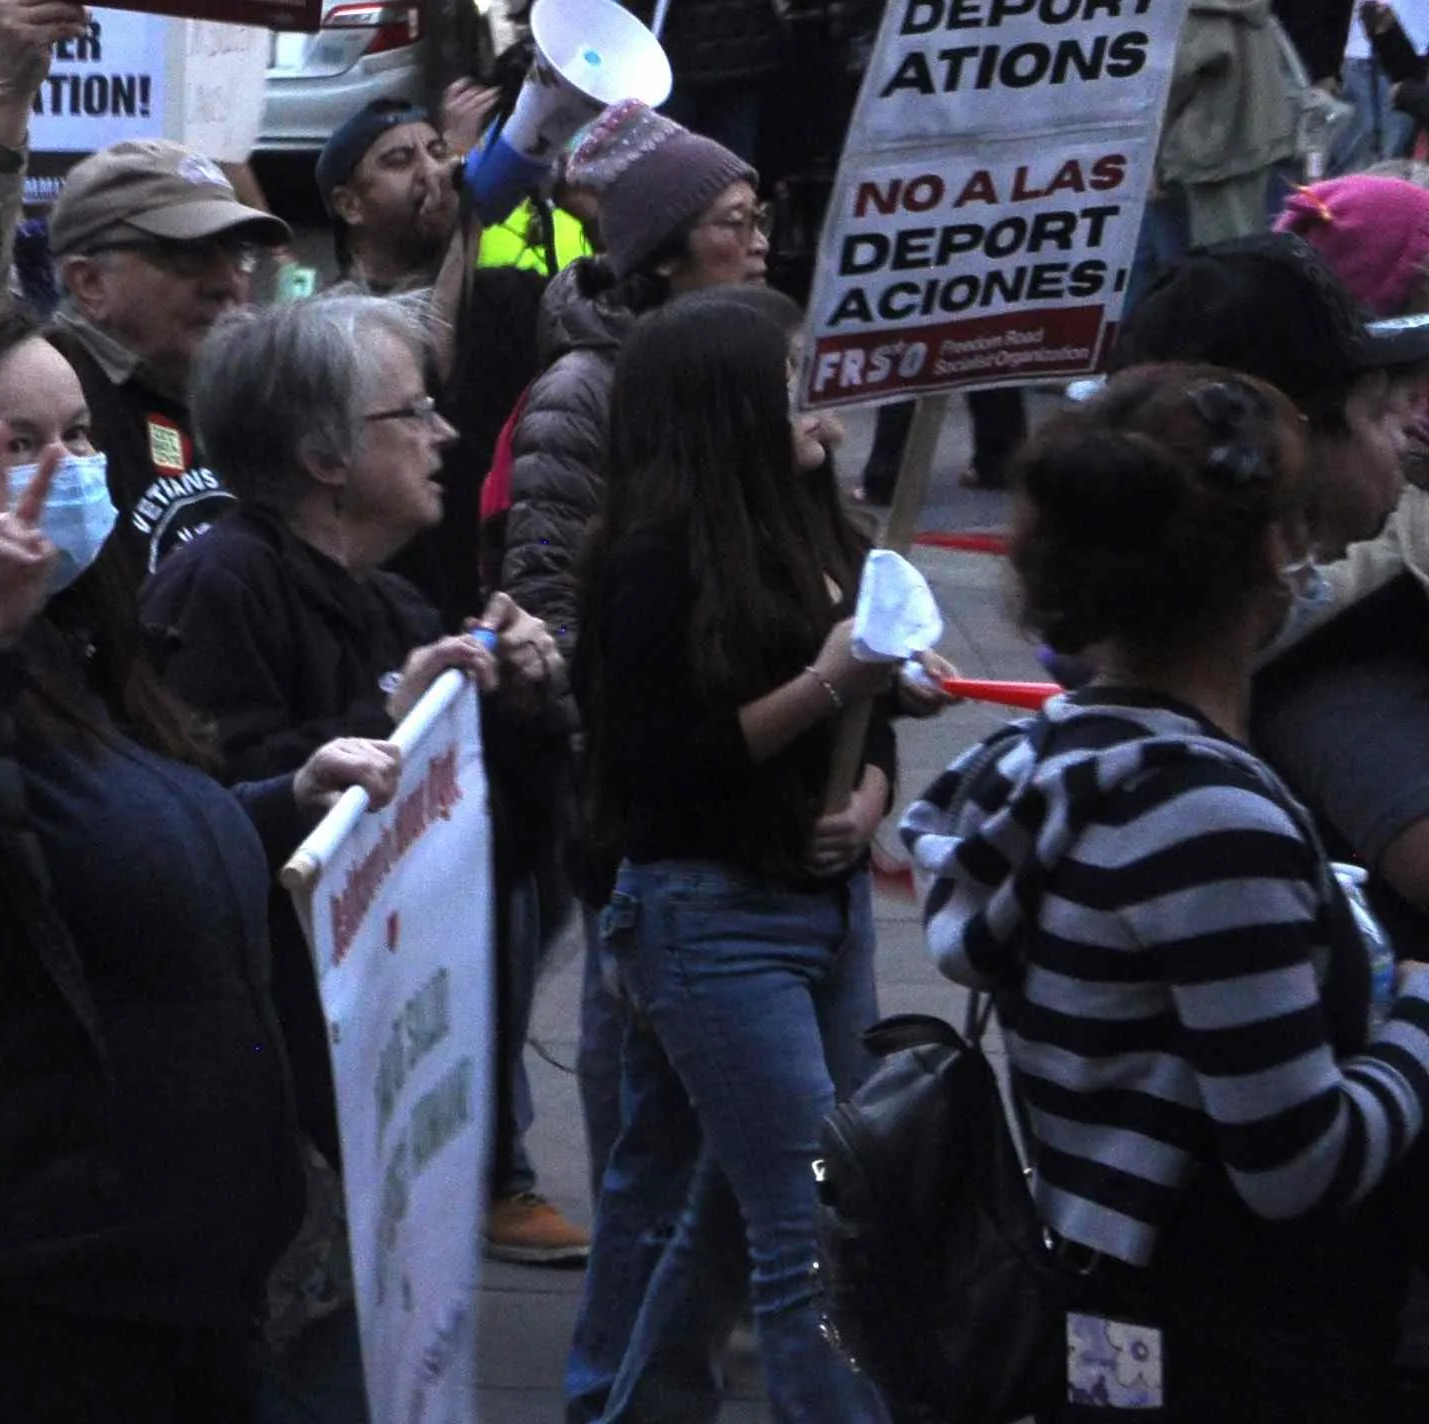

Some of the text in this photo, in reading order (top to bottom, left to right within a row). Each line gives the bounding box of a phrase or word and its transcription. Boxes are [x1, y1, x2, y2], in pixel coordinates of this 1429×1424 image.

[879, 31, 1149, 98] ATIONS
[853, 154, 1127, 219] NO A LAS
[838, 206, 1121, 276] DEPORT
[825, 259, 1108, 327] ACIONES
